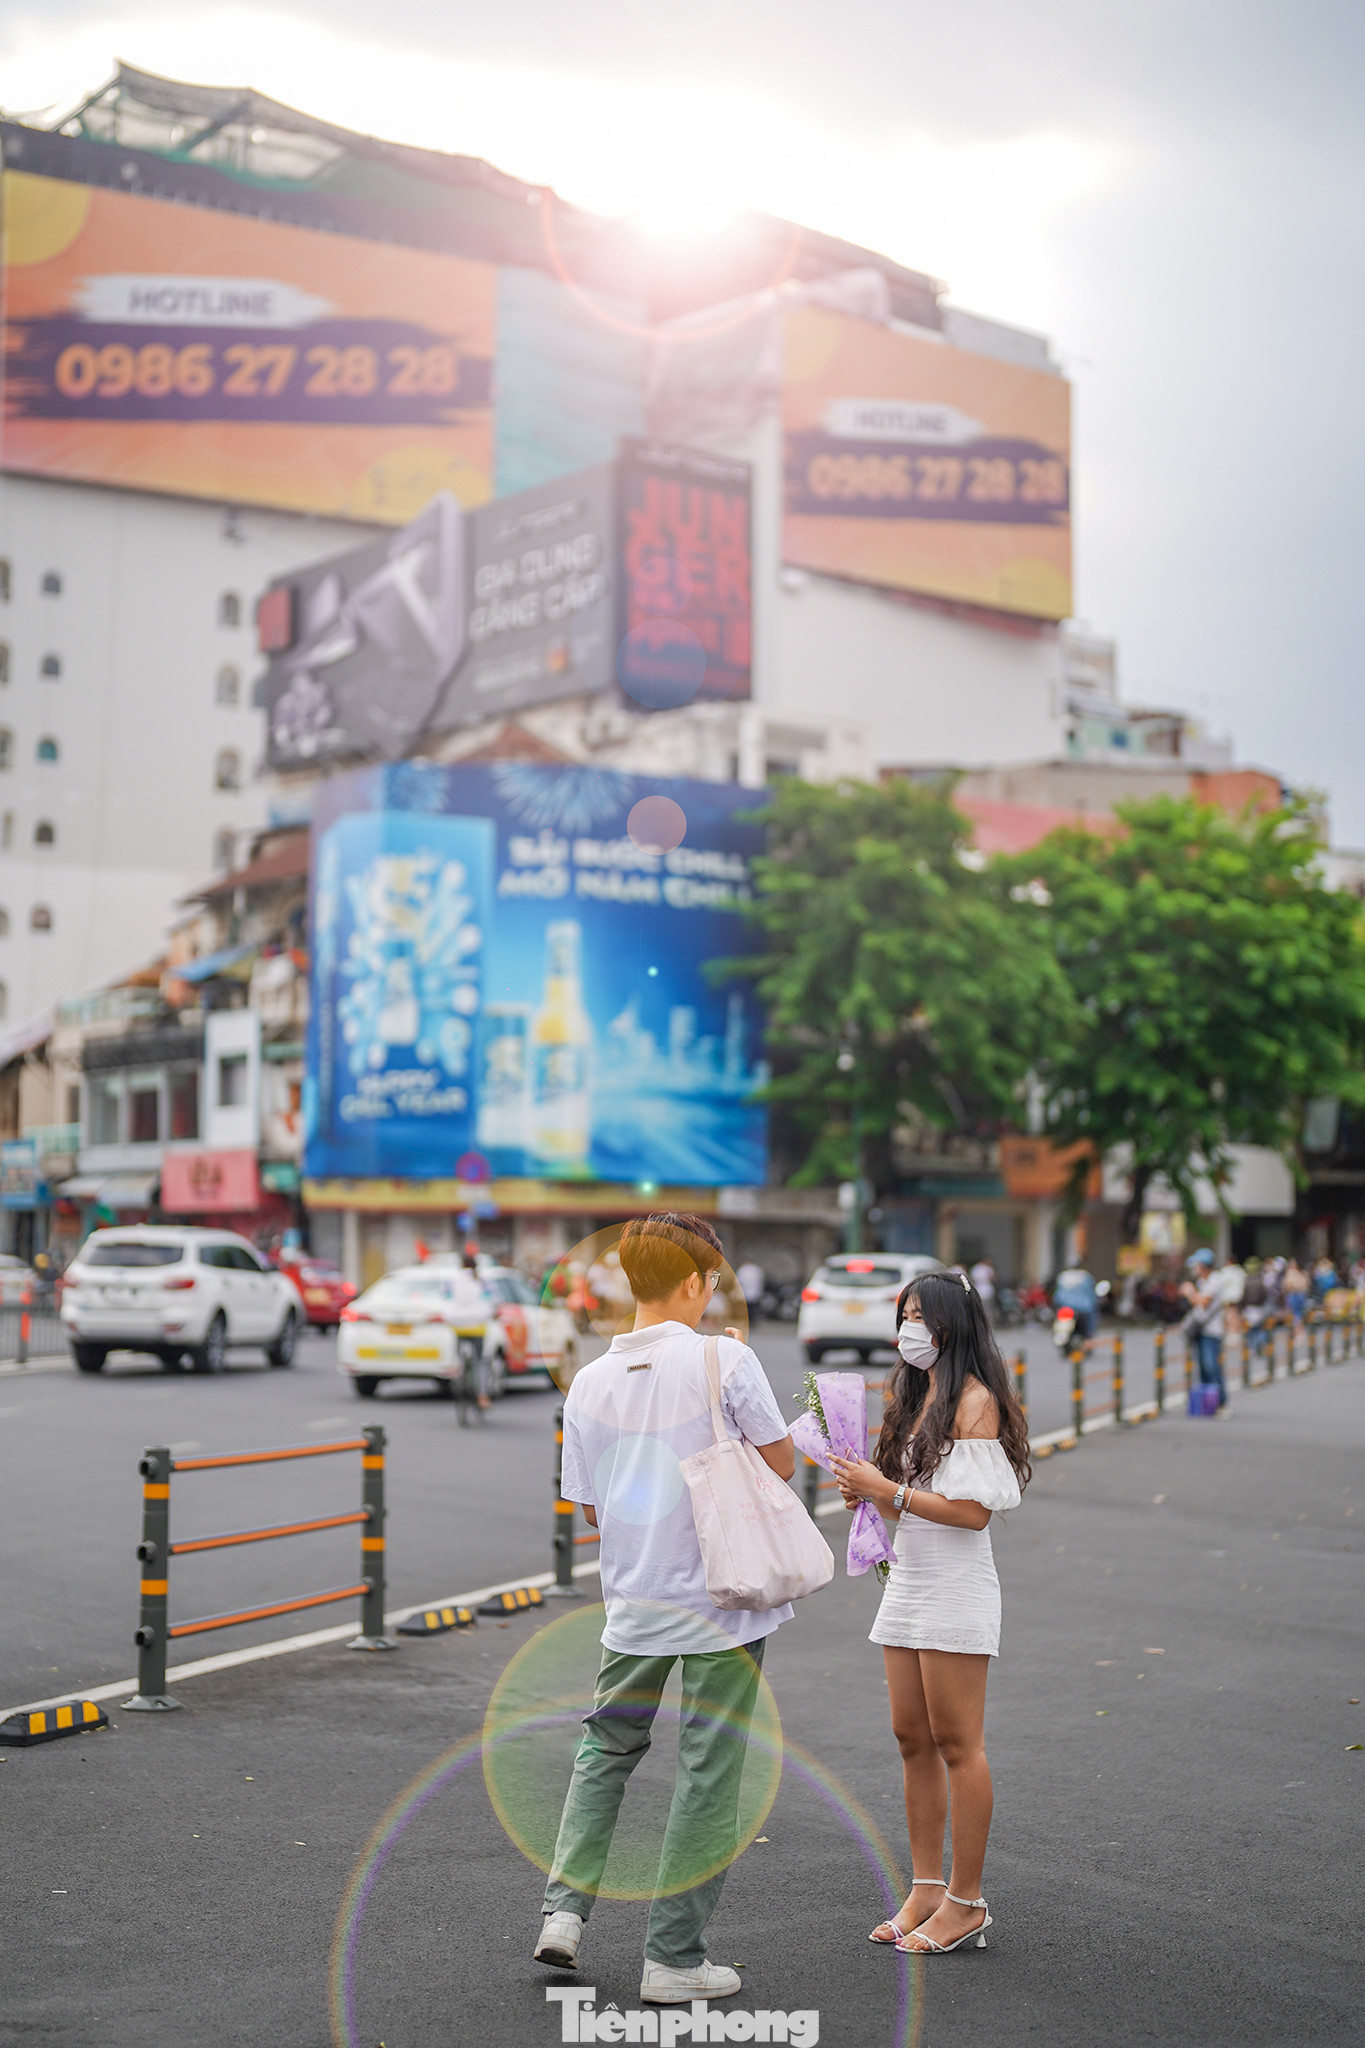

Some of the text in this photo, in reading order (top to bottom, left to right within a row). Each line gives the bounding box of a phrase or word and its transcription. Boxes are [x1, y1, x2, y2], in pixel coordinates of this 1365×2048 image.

[128, 286, 275, 317] HOTLINE
[54, 342, 459, 398] 0986 27 28 28
[853, 409, 947, 432] HOTLINE
[917, 455, 964, 501] 27
[967, 456, 1015, 504] 28
